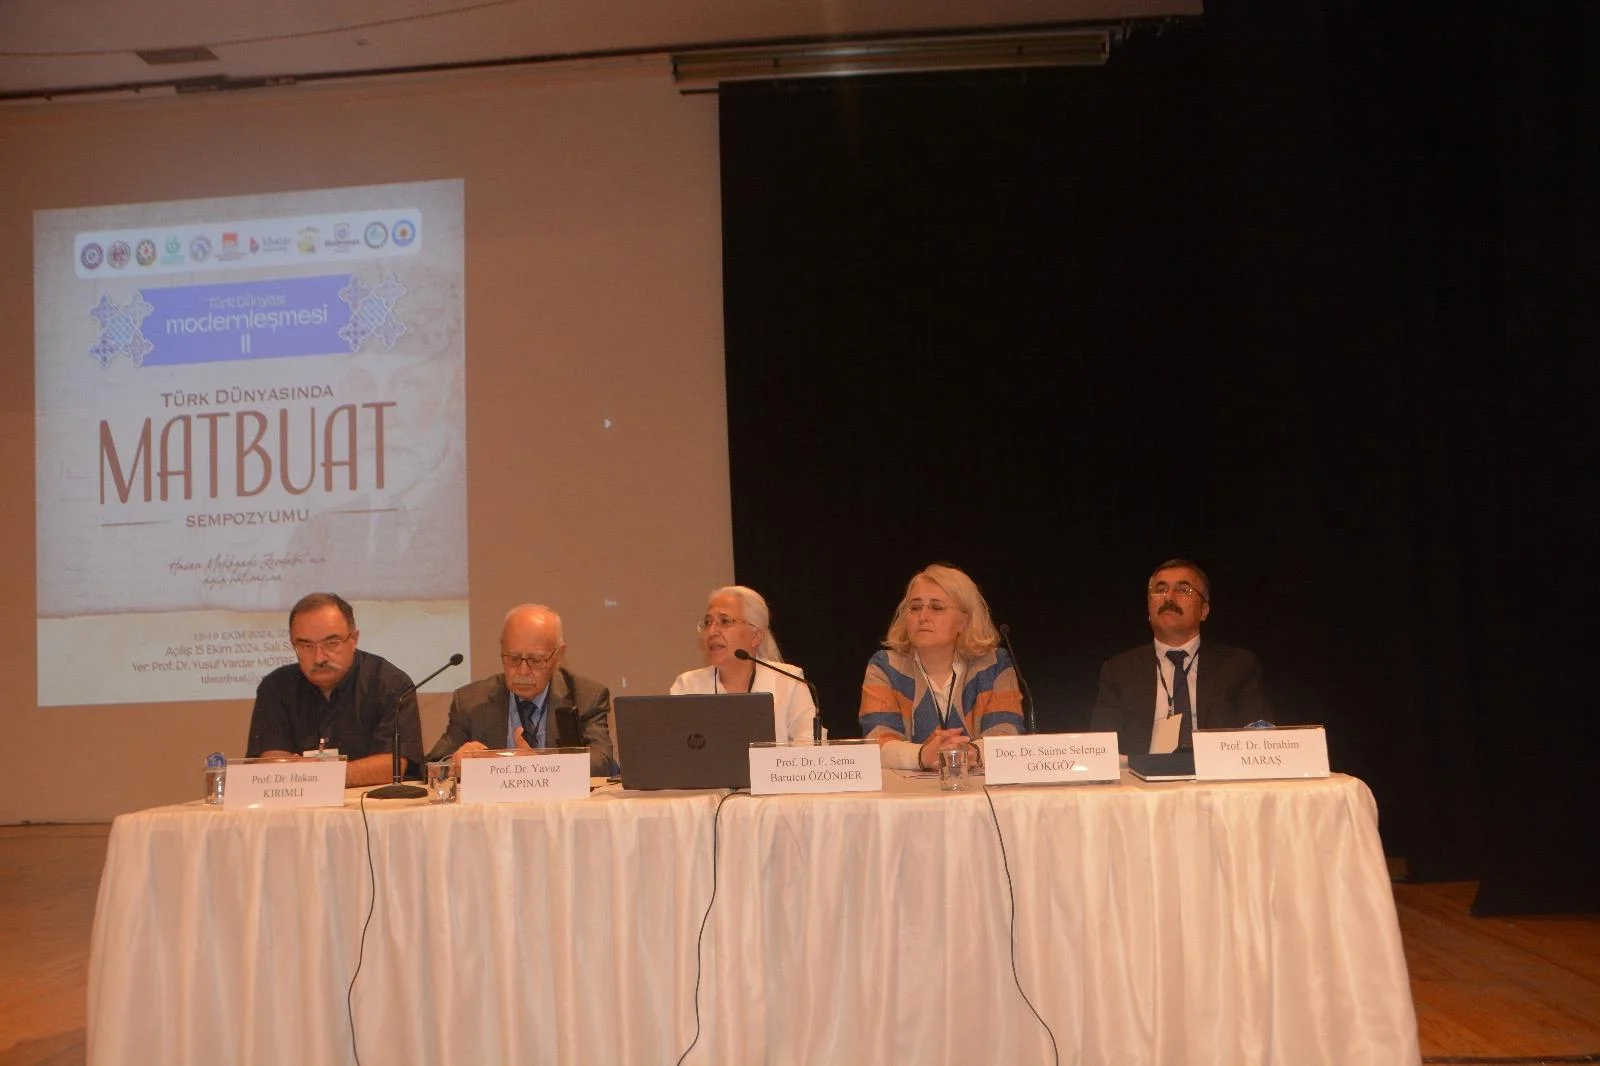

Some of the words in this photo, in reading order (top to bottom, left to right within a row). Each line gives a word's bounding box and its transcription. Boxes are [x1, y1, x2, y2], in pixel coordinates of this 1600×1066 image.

[165, 302, 328, 335] modernleşmesi
[160, 390, 210, 407] TÜRK
[215, 385, 334, 405] DÜNYASINDA
[100, 401, 397, 504] MATBUAT
[185, 509, 309, 528] SEMPOZYUMU
[206, 643, 232, 654] Ekim
[176, 660, 190, 670] Dr.
[192, 658, 220, 670] Yusuf
[220, 657, 255, 669] Vardar
[1220, 741, 1243, 750] Prof.
[1246, 741, 1260, 750] Dr.
[995, 748, 1017, 758] Doç.
[1020, 747, 1035, 757] Dr.
[1038, 746, 1067, 755] Saime
[1069, 745, 1106, 756] Selenga
[776, 758, 798, 767] Prof.
[801, 758, 815, 766] Dr.
[831, 757, 855, 765] Sema
[1027, 760, 1076, 771] GÖKGÖZ
[1241, 755, 1282, 766] MARAŞ
[490, 764, 511, 774] Prof.
[532, 764, 561, 773] Yavuz
[251, 775, 271, 785] Prof.
[274, 774, 287, 783] Dr.
[290, 773, 318, 783] Hakan
[808, 770, 862, 781] ÖZÖNDER
[500, 778, 549, 789] AKPINAR
